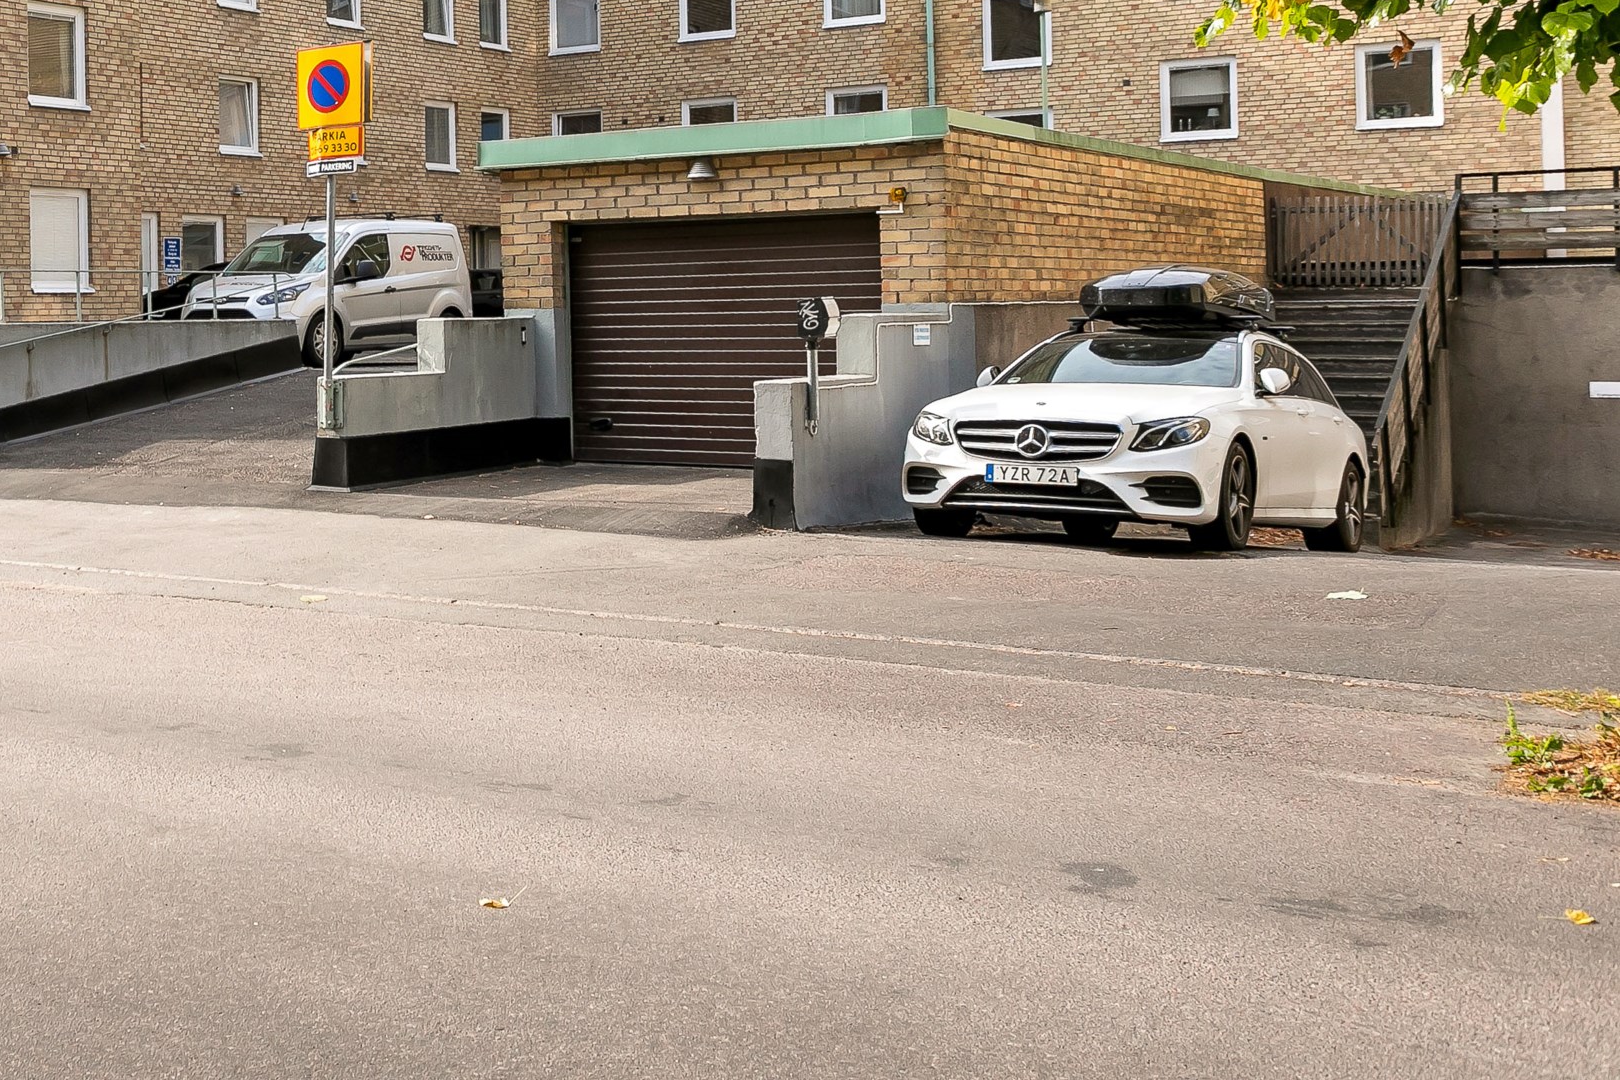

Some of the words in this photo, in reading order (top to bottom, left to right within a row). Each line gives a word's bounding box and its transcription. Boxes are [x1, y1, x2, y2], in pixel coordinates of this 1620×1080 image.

[331, 143, 342, 153] 33
[344, 142, 357, 152] 30
[321, 162, 352, 172] PARKERING
[1000, 466, 1031, 482] YZR
[1036, 467, 1070, 483] 72A
